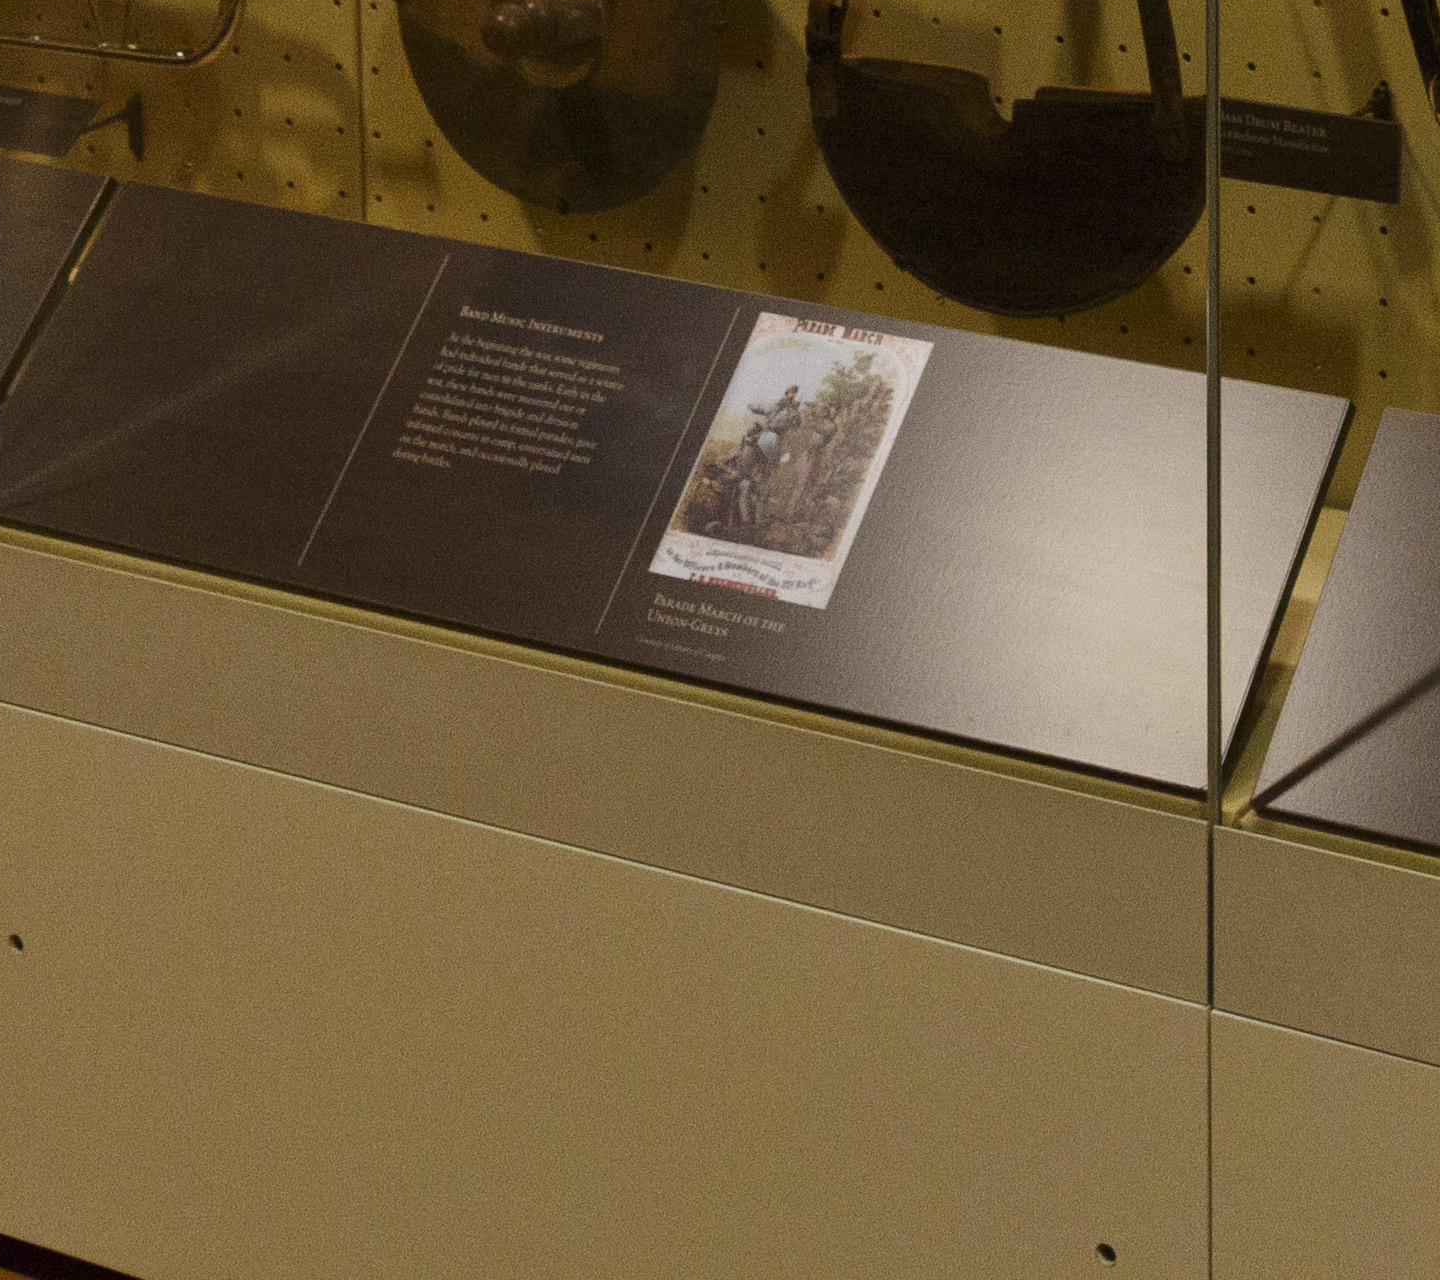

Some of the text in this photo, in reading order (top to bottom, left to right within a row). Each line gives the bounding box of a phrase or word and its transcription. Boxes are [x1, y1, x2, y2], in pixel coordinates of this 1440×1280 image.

[1244, 113, 1281, 130] DRUM
[1282, 118, 1328, 137] BEATER
[654, 592, 787, 632] PARADE MARCH OF THE
